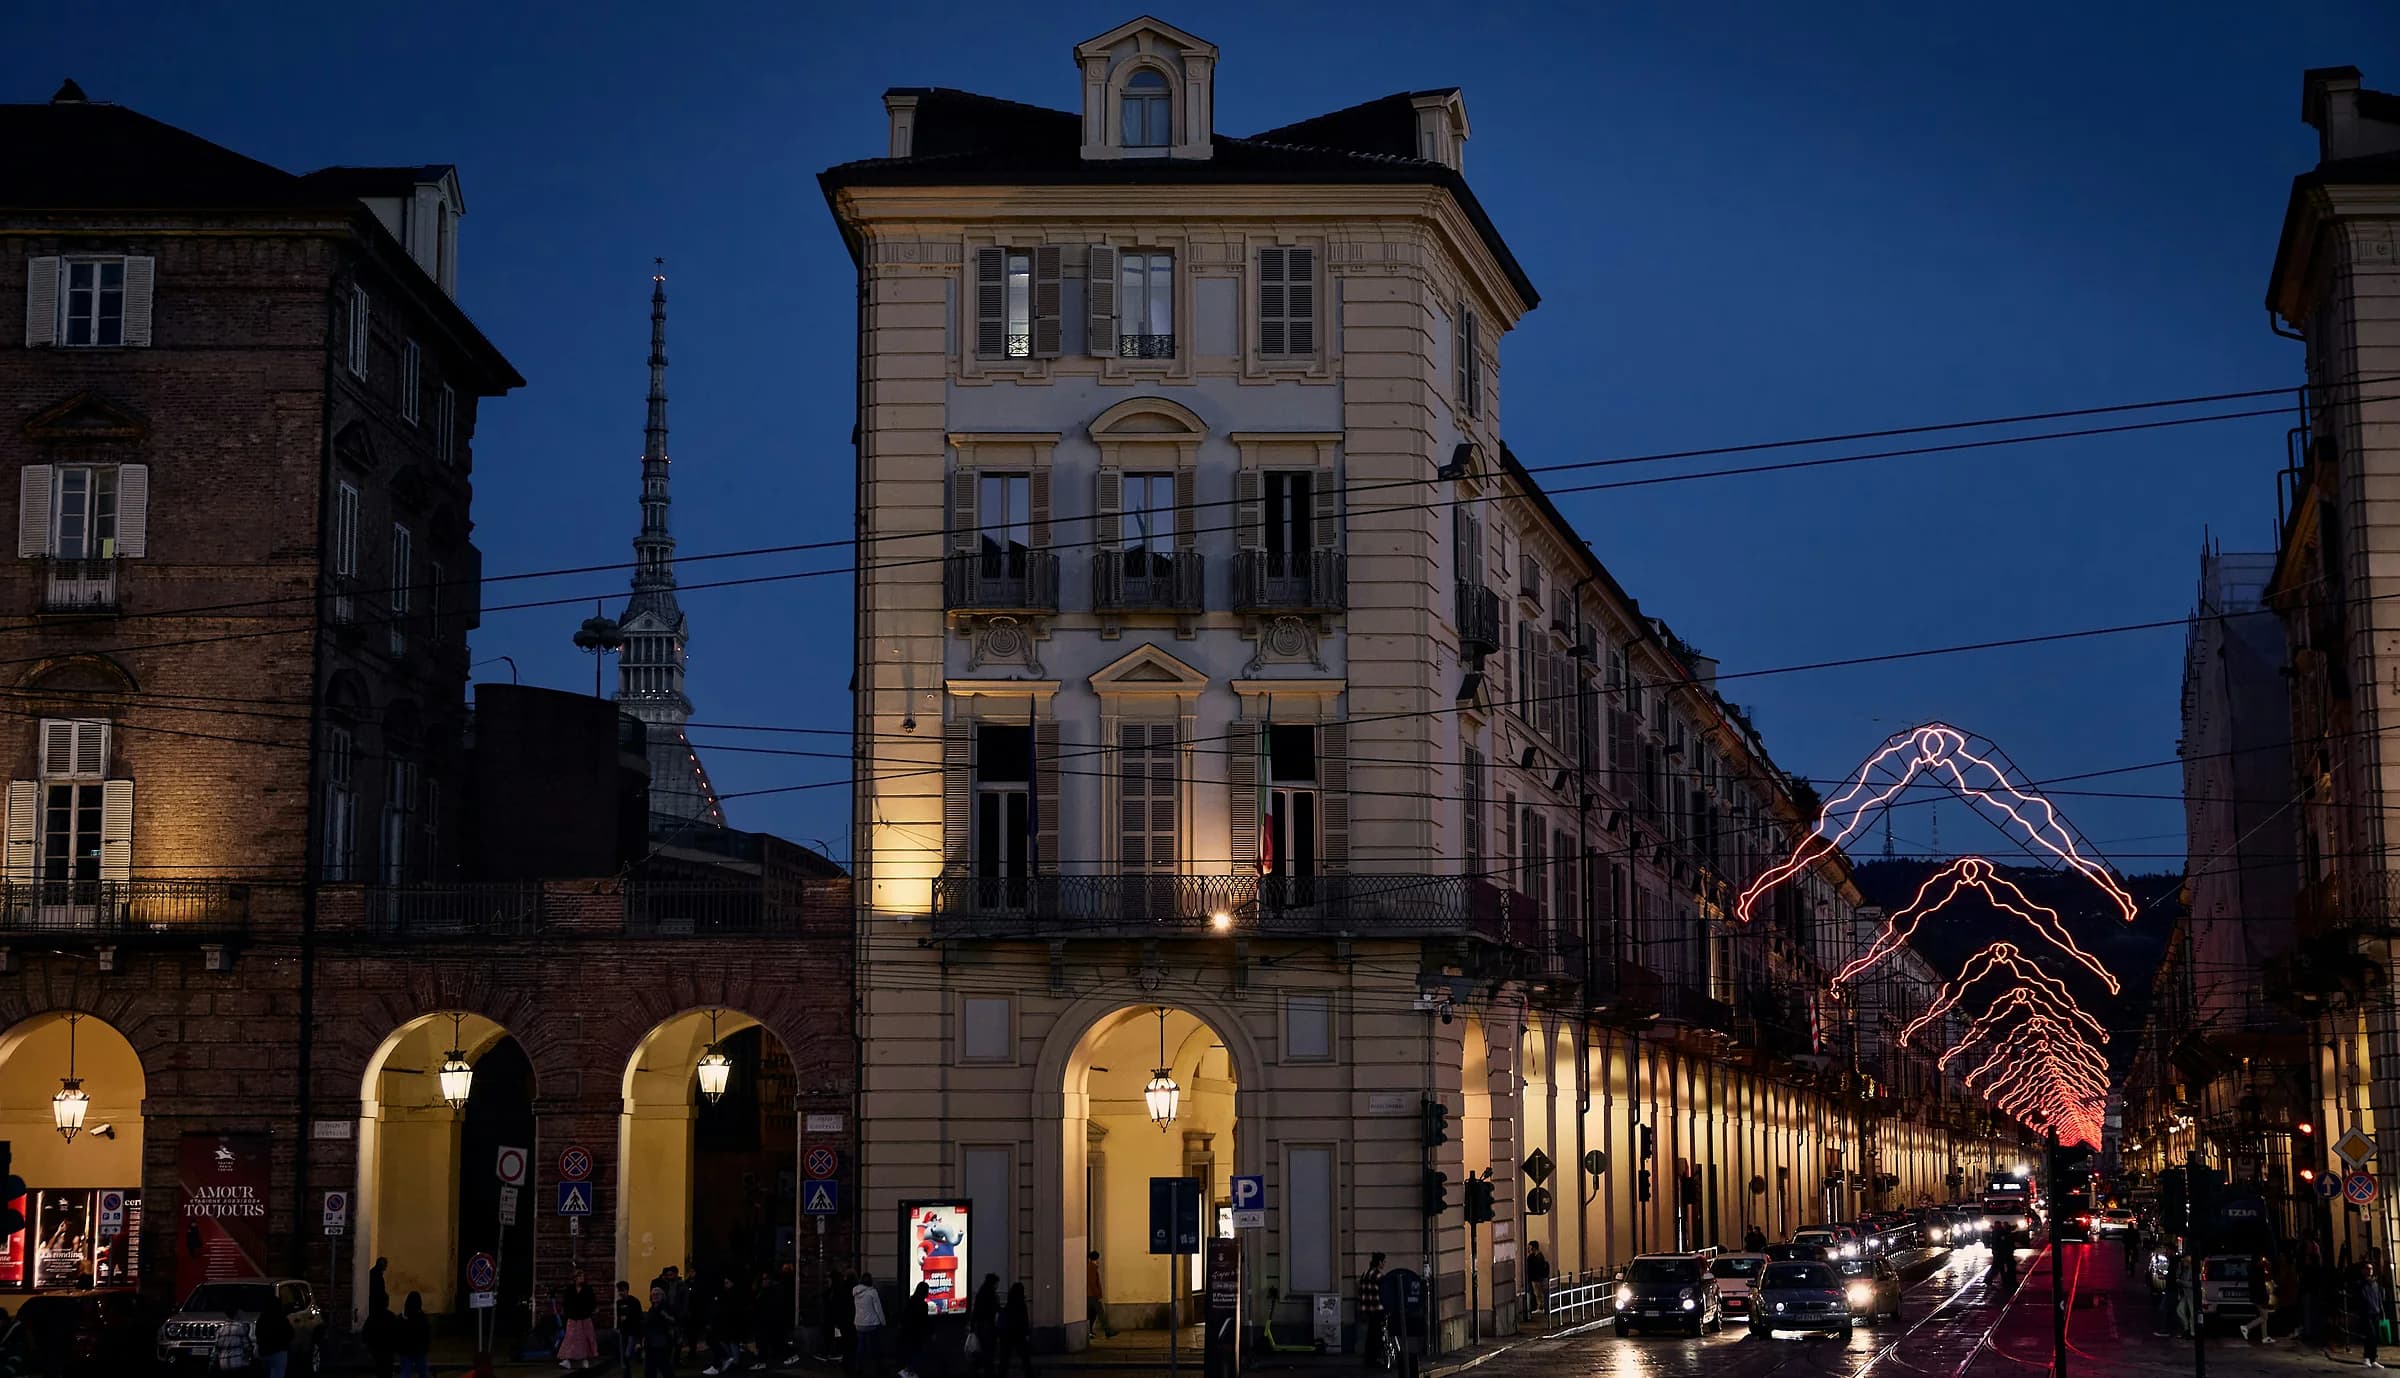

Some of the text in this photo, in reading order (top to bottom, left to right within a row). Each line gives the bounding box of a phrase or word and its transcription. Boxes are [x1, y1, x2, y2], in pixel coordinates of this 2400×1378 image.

[195, 1185, 254, 1199] AMOUR
[1237, 1179, 1258, 1208] P
[184, 1203, 265, 1218] TOUJOURS
